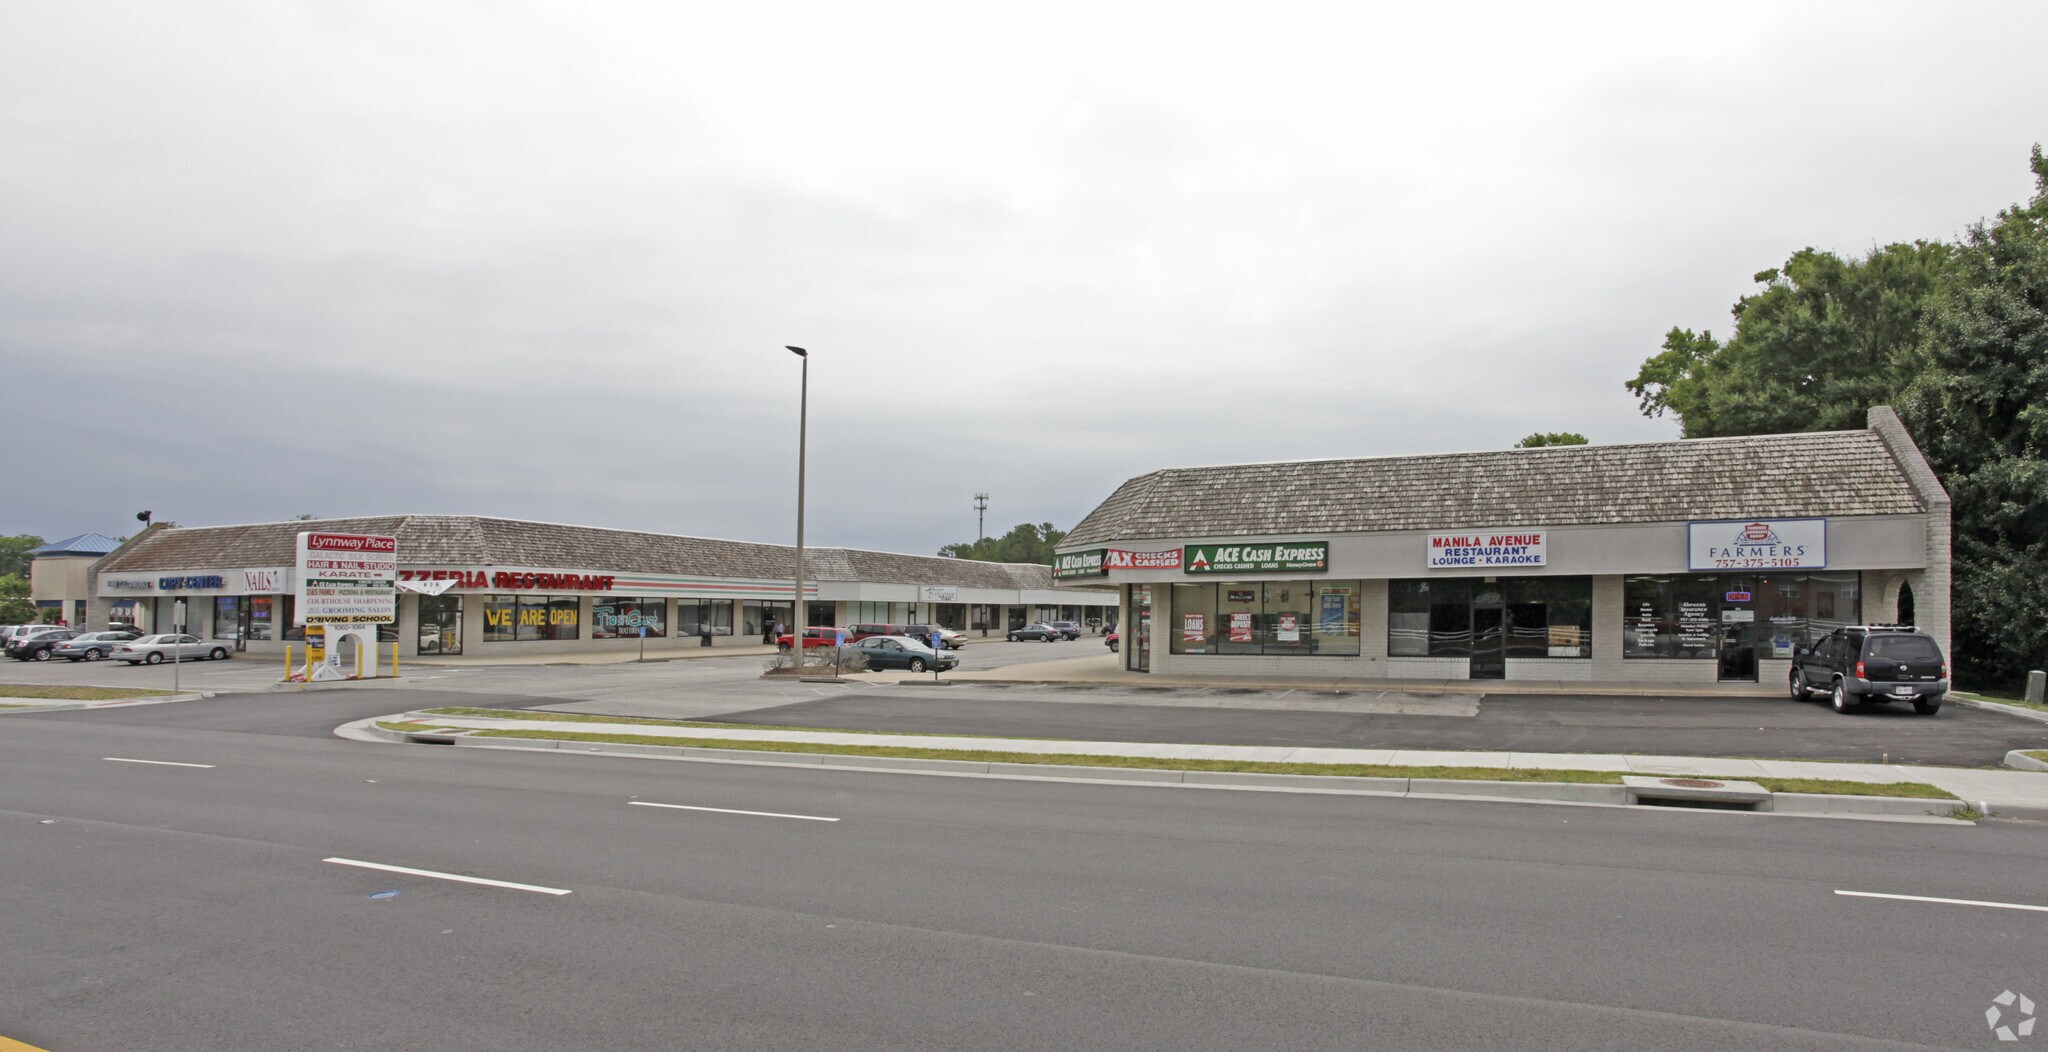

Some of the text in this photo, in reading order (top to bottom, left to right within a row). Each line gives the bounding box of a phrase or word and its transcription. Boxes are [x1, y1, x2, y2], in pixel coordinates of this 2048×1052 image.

[312, 536, 393, 550] Lynnway Place
[1433, 535, 1540, 547] MANILA AVENUE
[310, 551, 345, 560] GALACTIC
[1135, 551, 1178, 559] CHECKS
[1213, 546, 1325, 562] ACE CASH EXPRESS
[1445, 547, 1527, 556] RESTAURANT
[1709, 546, 1805, 557] FARMERS
[1062, 556, 1071, 569] ACE
[1083, 554, 1101, 568] EXPRESS
[1106, 551, 1134, 566] AX
[1135, 559, 1179, 567] CASHED
[1433, 556, 1540, 565] LOUNGE KARAOKE
[1716, 558, 1800, 568] 757-375-5105
[308, 561, 329, 569] HAIR
[364, 562, 394, 570] STUDIO
[159, 577, 184, 590] COPY
[186, 575, 223, 589] CENTER
[245, 571, 272, 591] NAILS
[495, 571, 615, 590] RESTAURANT
[486, 609, 577, 626] WE ARE OPEN
[1185, 619, 1203, 630] LOANS
